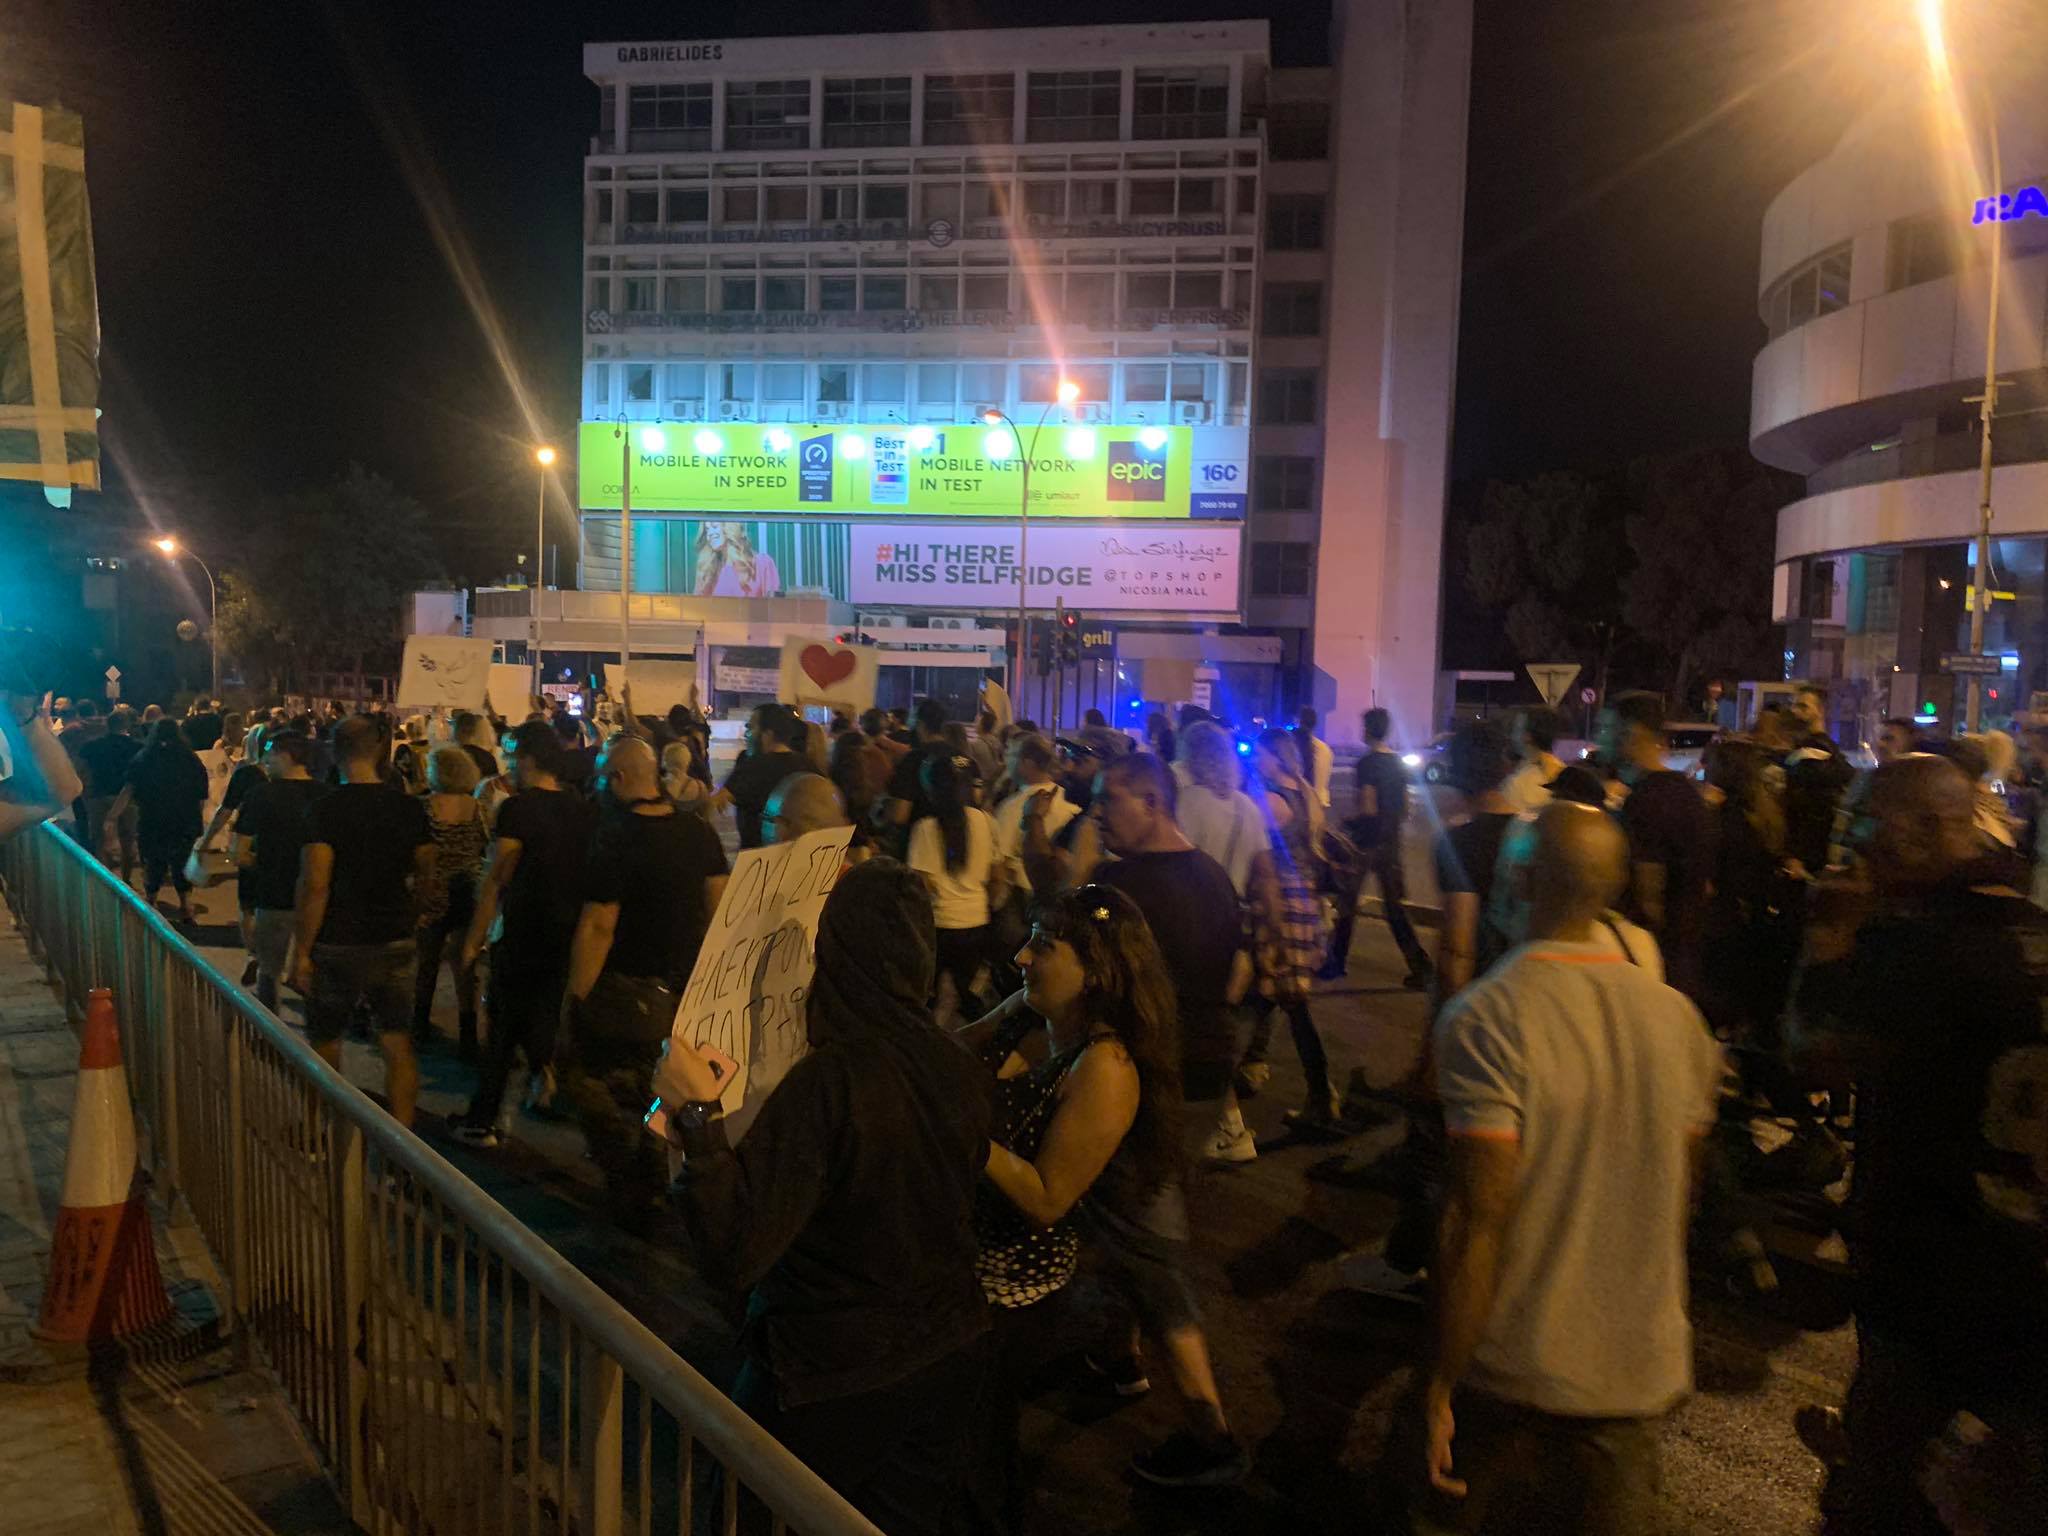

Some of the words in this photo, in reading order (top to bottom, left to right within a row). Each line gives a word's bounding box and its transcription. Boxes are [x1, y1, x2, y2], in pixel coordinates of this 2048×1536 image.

[617, 45, 723, 62] GABRIELIDES
[639, 455, 700, 468] MOBILE
[706, 456, 787, 469] NETWORK
[920, 458, 984, 471] MOBILE
[989, 459, 1076, 473] NETWORK
[1110, 459, 1163, 483] epic
[714, 475, 730, 488] IN
[736, 475, 788, 489] SPEED
[920, 478, 937, 491] IN
[943, 478, 983, 492] TEST
[876, 543, 919, 563] #HI
[928, 544, 1015, 565] THERE
[876, 564, 937, 584] MISS
[944, 565, 1093, 587] SELFRIDGE
[1119, 586, 1170, 596] NICOSIA
[1175, 587, 1208, 597] MALL
[724, 853, 792, 928] ΟΧΙ
[681, 926, 811, 1013] ΗΛΕΚΤΡΟΝ
